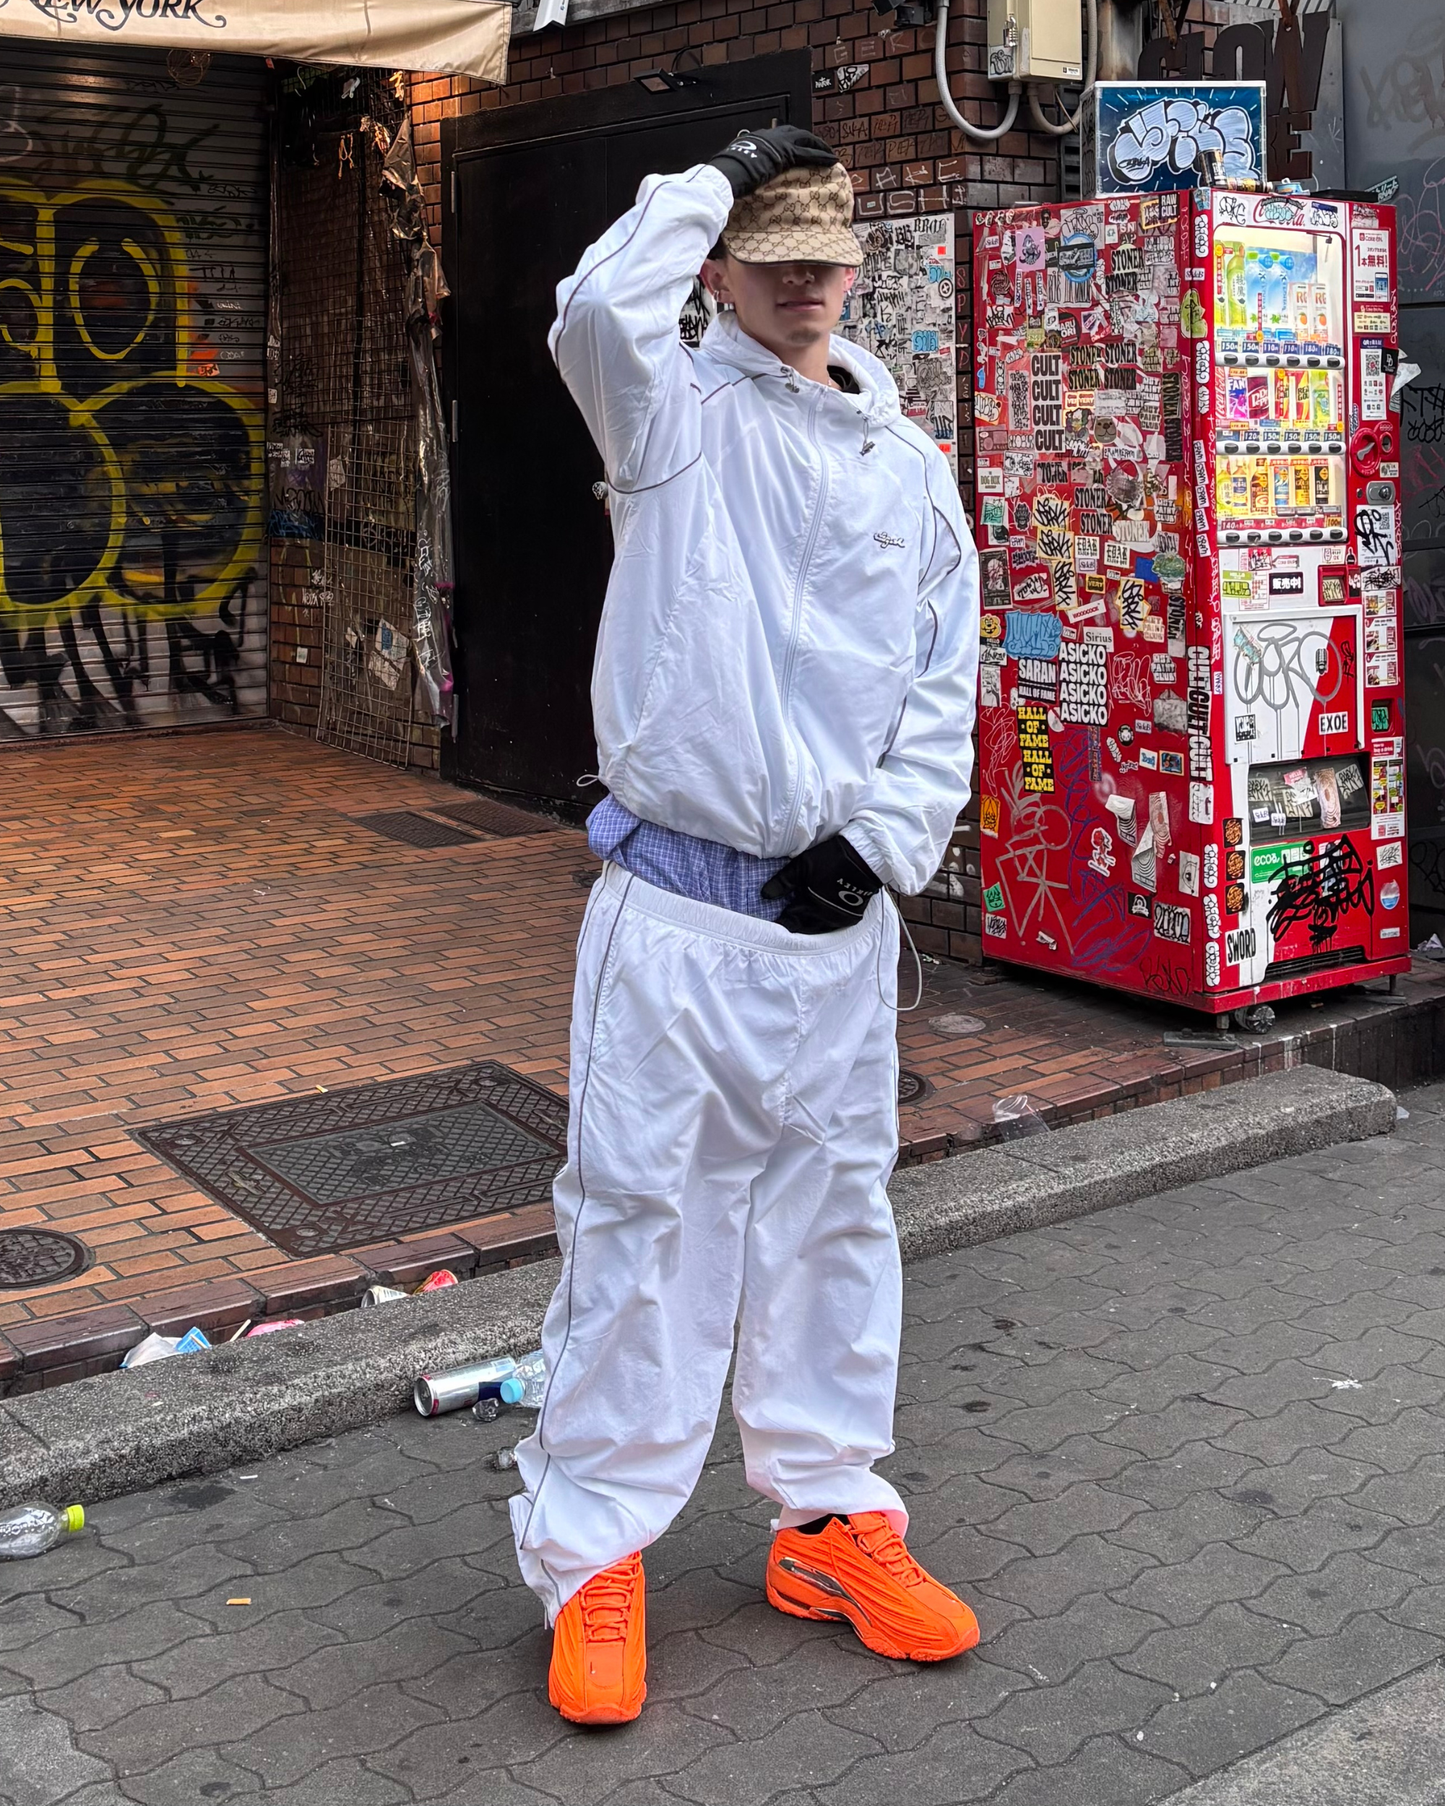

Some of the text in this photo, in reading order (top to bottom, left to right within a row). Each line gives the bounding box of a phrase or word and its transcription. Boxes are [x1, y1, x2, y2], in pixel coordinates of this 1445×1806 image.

[1161, 194, 1177, 205] RAW
[1161, 205, 1178, 217] CULT
[1111, 249, 1145, 271] STONER
[1105, 272, 1138, 294] STONER
[1060, 321, 1075, 331] ARU
[1061, 329, 1076, 338] ORI
[1104, 343, 1138, 364] STONER
[1031, 354, 1062, 377] CULT
[1069, 369, 1101, 391] STONER
[1104, 368, 1137, 390] STONER
[1031, 379, 1062, 402] CULT
[1033, 404, 1062, 426] CULT
[1034, 429, 1065, 452] CULT
[1074, 487, 1107, 509] STONER
[1080, 512, 1114, 534] STONER
[1085, 631, 1112, 643] Sirius
[1059, 642, 1107, 665] ASICKO
[1019, 660, 1056, 683] SARAN
[1060, 662, 1108, 685] ASICKO
[1019, 686, 1056, 701] HALL OF FAME
[1060, 682, 1108, 705] ASICKO
[1018, 707, 1046, 720] HALL
[1061, 702, 1108, 725] ASICKO
[1320, 714, 1347, 733] EXOE
[1026, 721, 1040, 733] OF
[1020, 734, 1049, 748] FAME
[1023, 750, 1052, 763] HALL
[1031, 763, 1045, 777] OF
[1024, 777, 1055, 792] FAME
[1227, 928, 1256, 963] SWORD
